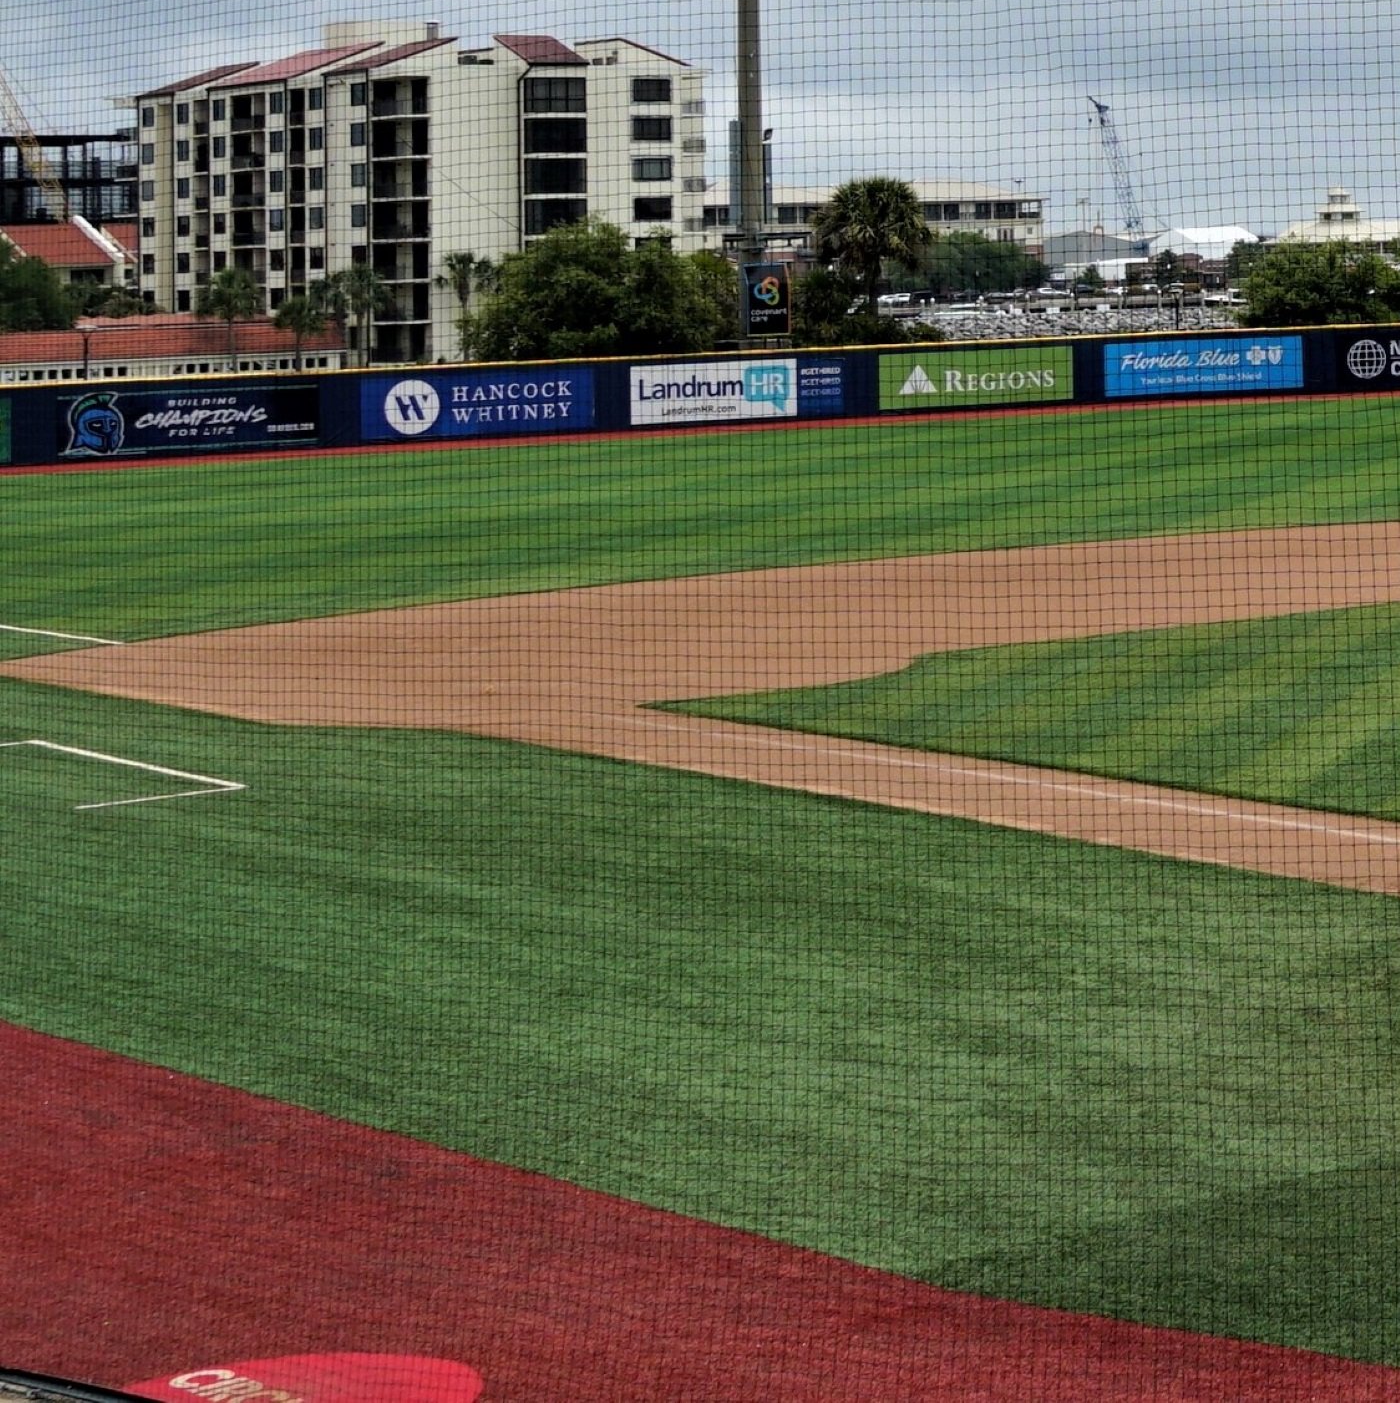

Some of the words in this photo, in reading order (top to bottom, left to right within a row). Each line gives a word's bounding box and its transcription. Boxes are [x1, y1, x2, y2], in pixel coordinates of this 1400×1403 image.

[1120, 350, 1194, 371] Florida
[1195, 348, 1240, 367] Blue
[452, 381, 572, 402] HANCOCK
[944, 369, 1054, 392] REGIONS
[168, 397, 237, 407] BUILDING
[452, 402, 572, 424] WHITNEY
[661, 404, 736, 416] LandrumHR.com
[135, 405, 268, 428] CHAMPIONS
[169, 428, 197, 437] FOR
[203, 426, 236, 436] LIFE
[168, 1369, 304, 1403] CIRC
